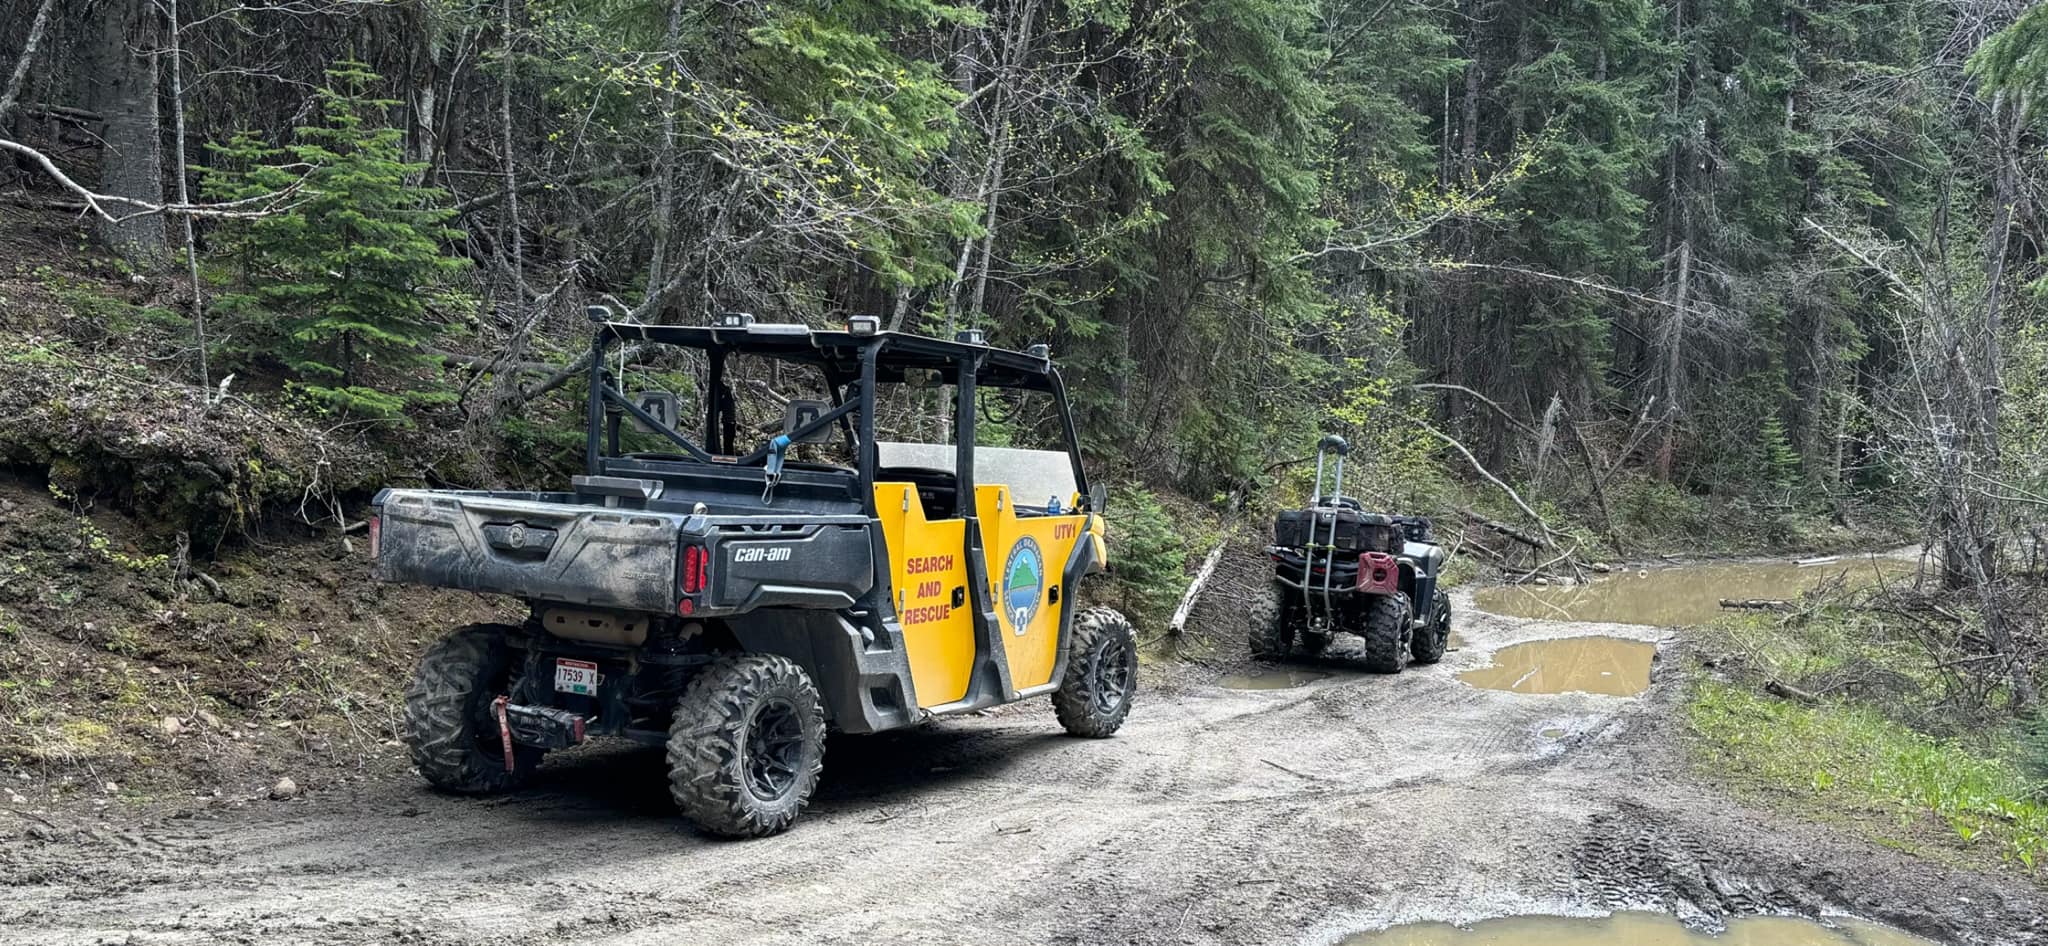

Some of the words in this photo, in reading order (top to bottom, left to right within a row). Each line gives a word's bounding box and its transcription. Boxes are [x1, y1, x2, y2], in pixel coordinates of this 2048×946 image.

[1055, 524, 1075, 540] UTV1
[734, 547, 792, 562] can-am
[907, 555, 953, 575] SEARCH
[917, 581, 942, 598] AND
[905, 604, 950, 625] RESCUE
[558, 668, 583, 682] 17539
